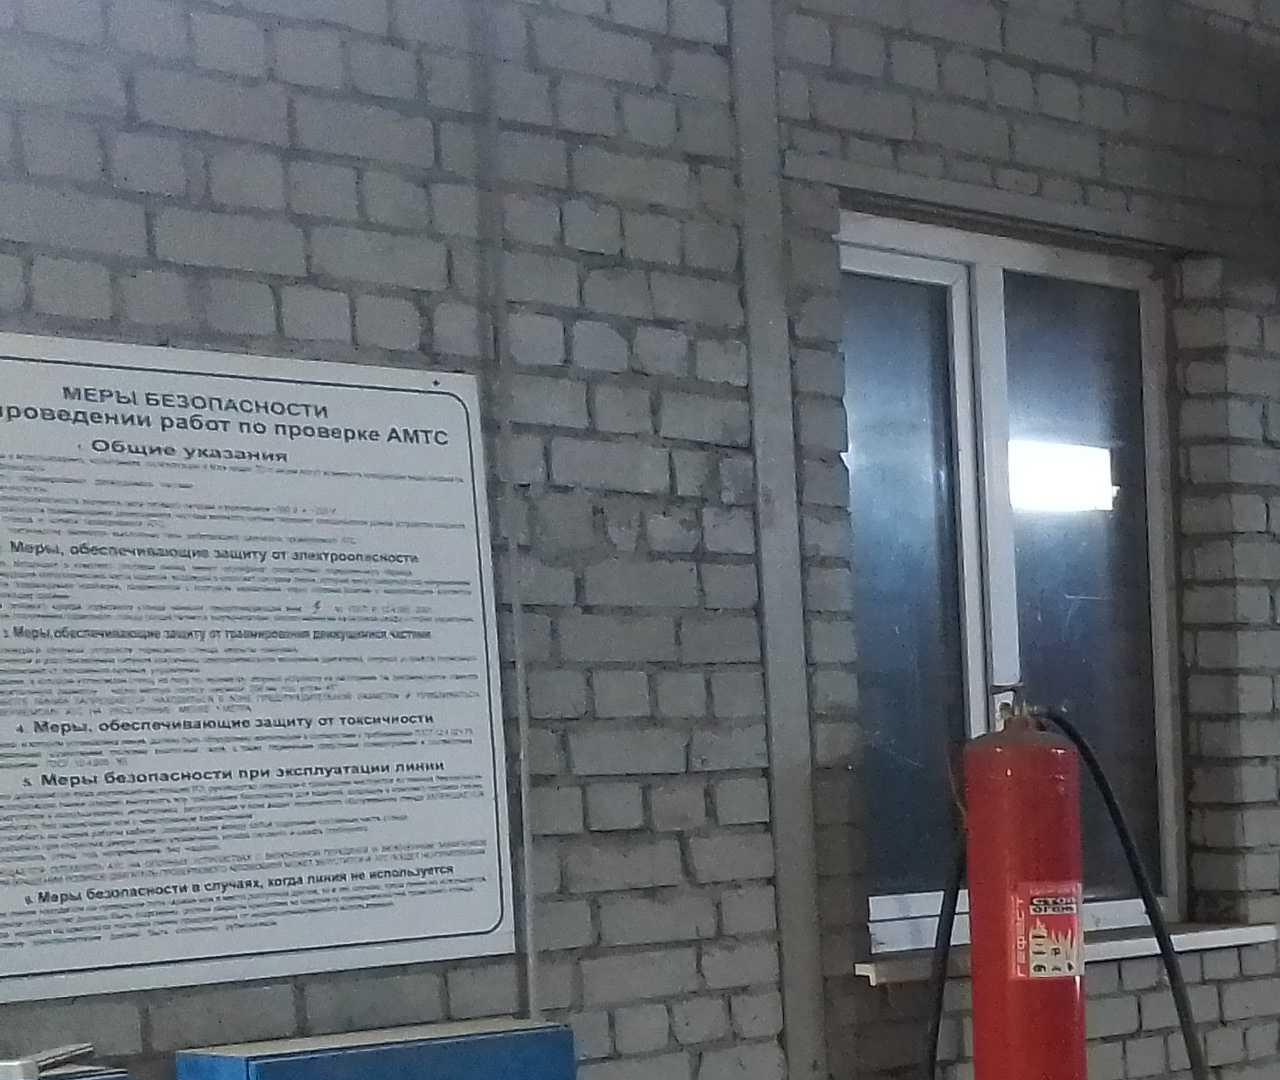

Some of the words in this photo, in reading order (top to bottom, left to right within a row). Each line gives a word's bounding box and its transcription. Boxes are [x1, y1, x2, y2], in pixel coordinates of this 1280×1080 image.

[62, 385, 137, 406] МЕРЫ
[145, 391, 328, 419] БЕЗОПАСНОСТИ
[0, 404, 151, 428] роведении
[160, 414, 231, 432] работ
[239, 420, 266, 435] по
[275, 423, 381, 443] проверке
[387, 427, 449, 446] АМТС
[91, 439, 176, 457] Общие
[184, 448, 288, 463] указания
[70, 543, 209, 560] обеспечивающие
[214, 550, 266, 563] защиту
[272, 551, 287, 561] от
[98, 718, 250, 733] обеспечивающие
[256, 717, 312, 729] защиту
[318, 717, 334, 727] от
[340, 714, 433, 726] токсичности
[41, 774, 97, 788] Меры
[104, 768, 232, 784] безопасности
[239, 768, 270, 779] при
[276, 763, 390, 778] эксплуатации
[395, 762, 444, 773] линии
[38, 891, 82, 904] Меры
[86, 885, 188, 900] безопасности
[192, 884, 201, 893] в
[268, 877, 303, 888] когда
[307, 873, 347, 885] линия
[351, 872, 366, 881] не
[369, 864, 454, 880] используется
